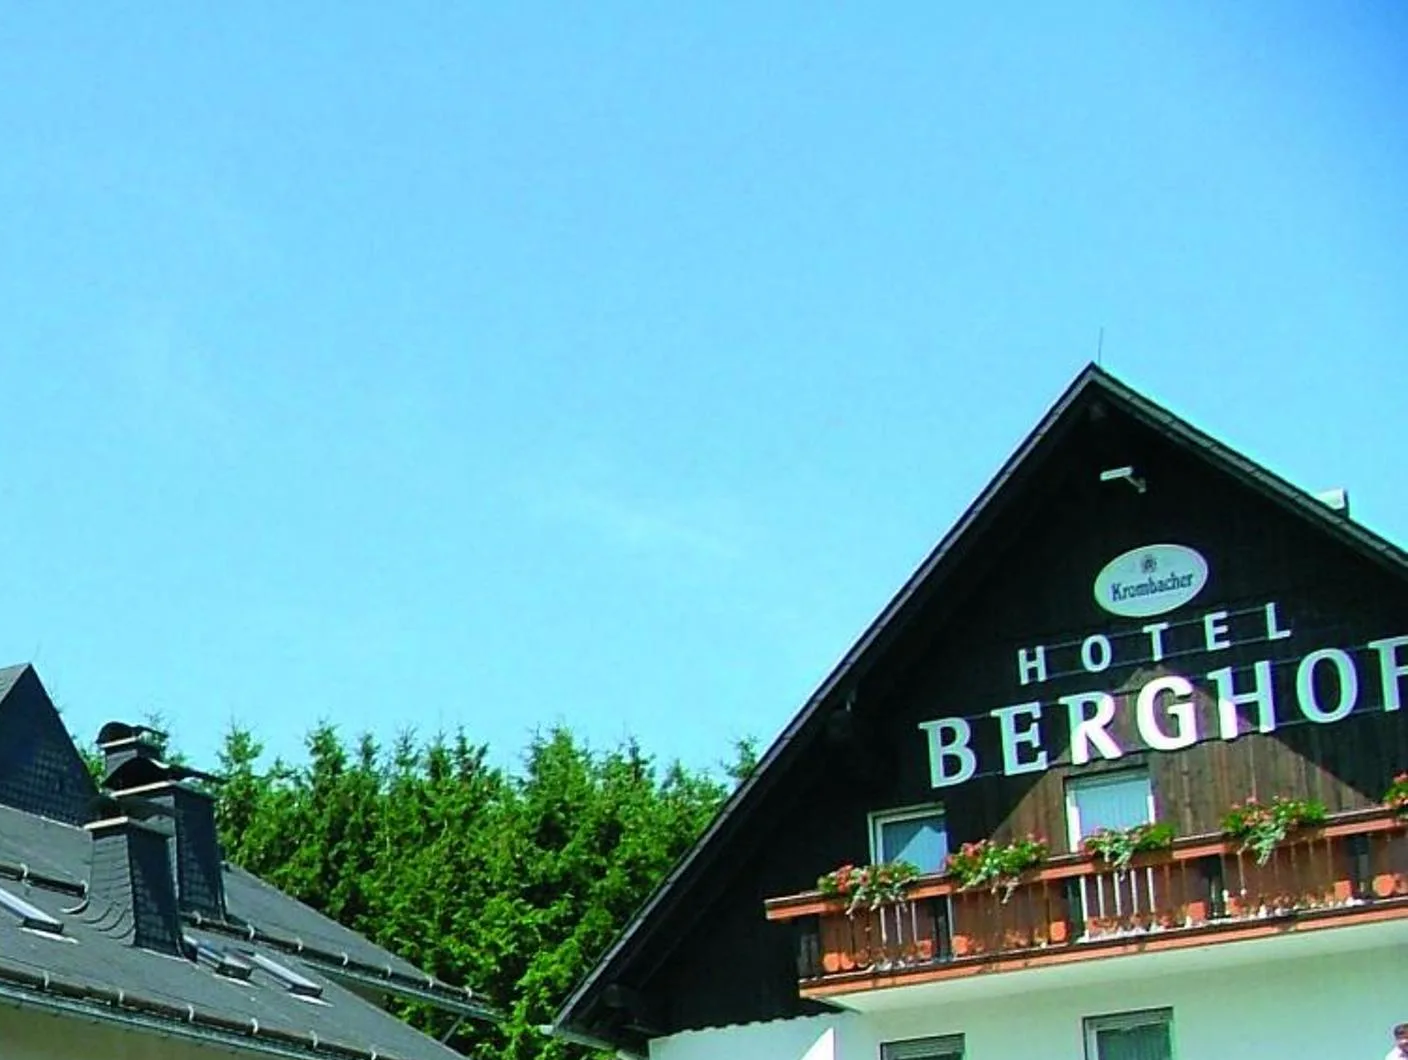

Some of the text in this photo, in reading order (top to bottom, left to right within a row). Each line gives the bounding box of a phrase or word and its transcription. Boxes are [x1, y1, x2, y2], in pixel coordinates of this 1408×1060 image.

[1110, 571, 1194, 602] Krombacher
[1018, 602, 1291, 685] HOTEL
[918, 634, 1408, 789] BERGHOF
